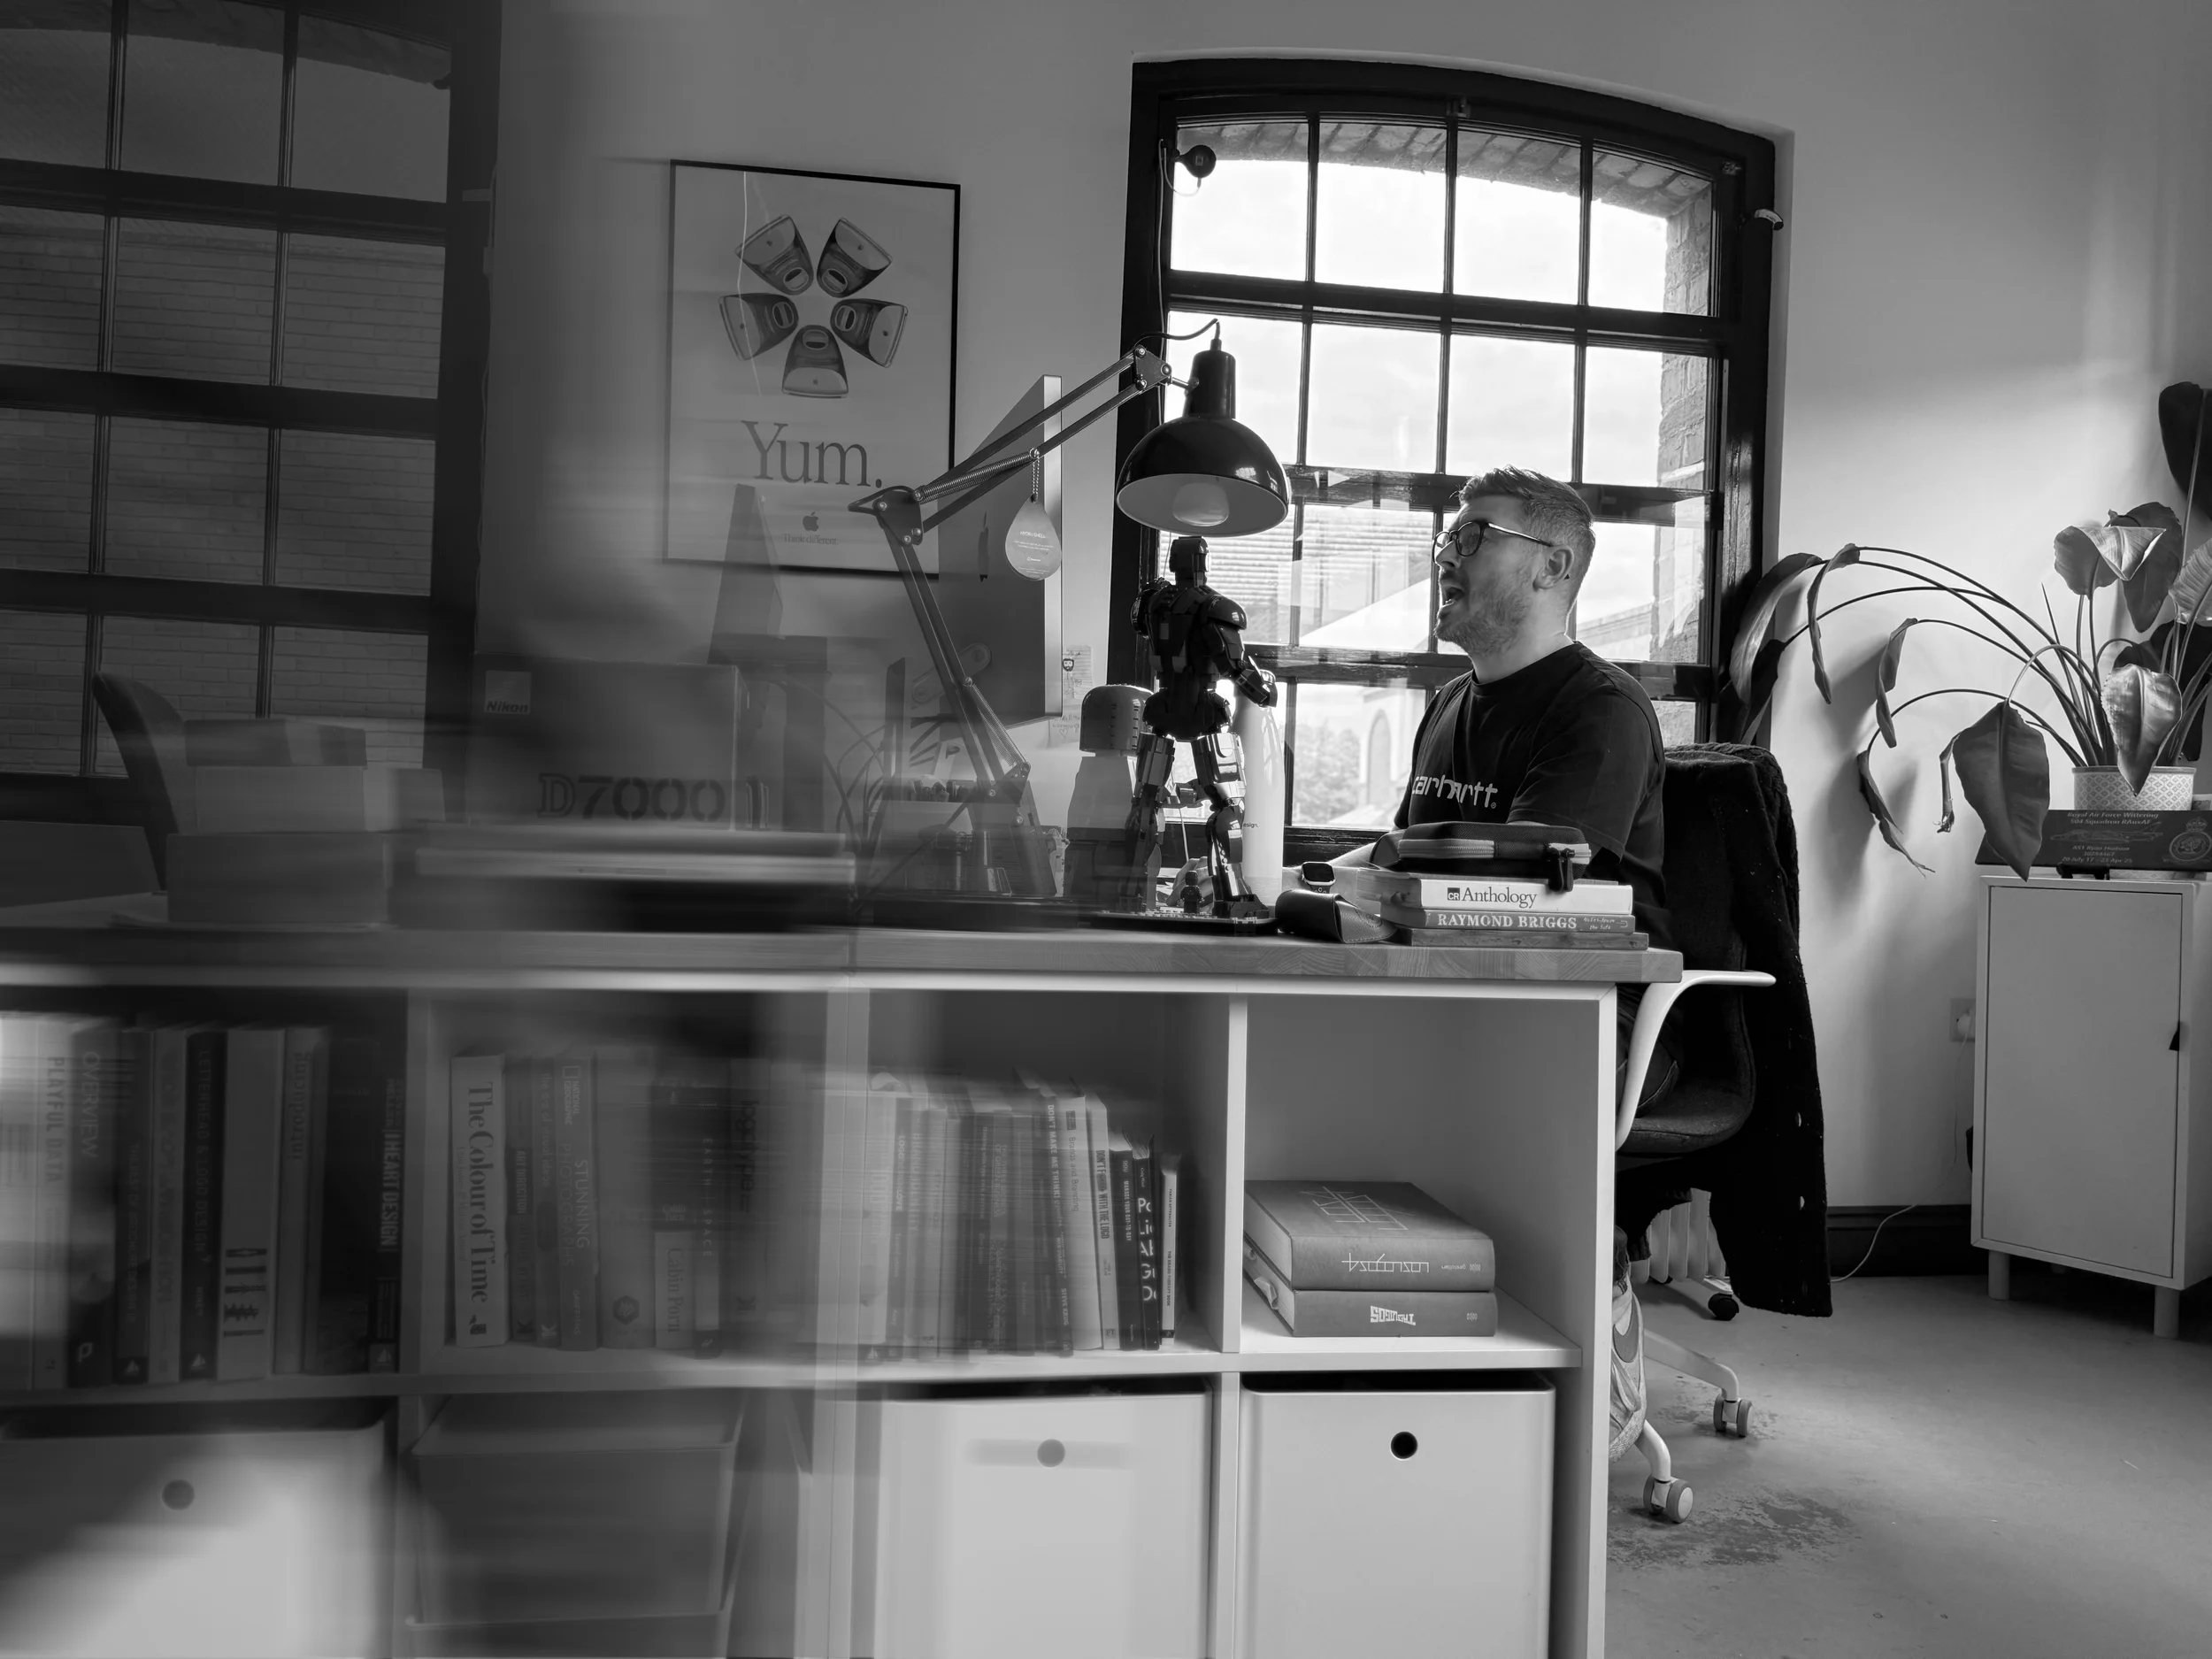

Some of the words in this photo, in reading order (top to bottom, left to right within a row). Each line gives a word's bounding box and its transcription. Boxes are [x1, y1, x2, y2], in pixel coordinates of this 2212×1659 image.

[741, 419, 883, 488] Yum.
[782, 533, 805, 543] Think
[805, 534, 839, 545] different.
[486, 700, 529, 714] Nikon
[536, 772, 726, 822] D7000
[1448, 892, 1461, 902] CR
[1462, 886, 1539, 910] Anthology
[1437, 914, 1514, 929] RAYMOND
[1517, 916, 1578, 931] BRIGGS
[45, 1056, 65, 1133] PLAYFUL
[196, 1050, 211, 1140] LETTERHEAD
[541, 1073, 554, 1090] the
[572, 1080, 581, 1117] NATIONAL
[81, 1050, 101, 1158] OVERVIEW
[286, 1052, 314, 1161] introducing
[385, 1078, 396, 1128] HELLER
[468, 1080, 495, 1130] The
[564, 1080, 572, 1127] GEOGRAPHIC
[1047, 1104, 1056, 1130] DON'T
[196, 1145, 210, 1155] &
[516, 1149, 528, 1166] ART
[541, 1125, 555, 1156] visual
[897, 1134, 906, 1158] LOGO
[910, 1133, 924, 1174] BRAND
[1049, 1131, 1058, 1154] MAKE
[1067, 1137, 1078, 1163] Brands
[45, 1138, 64, 1184] DATA
[195, 1159, 210, 1195] LOGO
[382, 1141, 401, 1189] HEART
[468, 1131, 495, 1211] Colour
[541, 1158, 554, 1188] ideas
[703, 1138, 713, 1187] EARTH
[1050, 1156, 1059, 1169] ME
[1069, 1163, 1079, 1178] and
[1095, 1150, 1106, 1169] DON'T
[516, 1168, 528, 1215] DIRECTION
[895, 1189, 904, 1211] LOVE
[1051, 1170, 1061, 1199] THINK!
[1070, 1179, 1081, 1212] Branding
[1097, 1193, 1109, 1210] WITH
[380, 1193, 400, 1246] DESIGN
[558, 1143, 575, 1268] PHOTOGRAPHS
[575, 1159, 591, 1250] STUNNING
[908, 1178, 923, 1233] IDENTITY
[1098, 1210, 1110, 1222] THE
[194, 1200, 209, 1253] DESIGN
[470, 1213, 496, 1240] of
[703, 1208, 713, 1257] SPACE
[1099, 1222, 1110, 1240] LOGO
[1124, 1214, 1133, 1242] DAY-TO-DAY
[470, 1240, 496, 1303] Time
[666, 1248, 686, 1294] Cabin
[572, 1288, 583, 1337] GRIFFITHS
[666, 1296, 685, 1334] Porn
[1060, 1287, 1069, 1307] STEVE
[1061, 1308, 1070, 1325] KRUG
